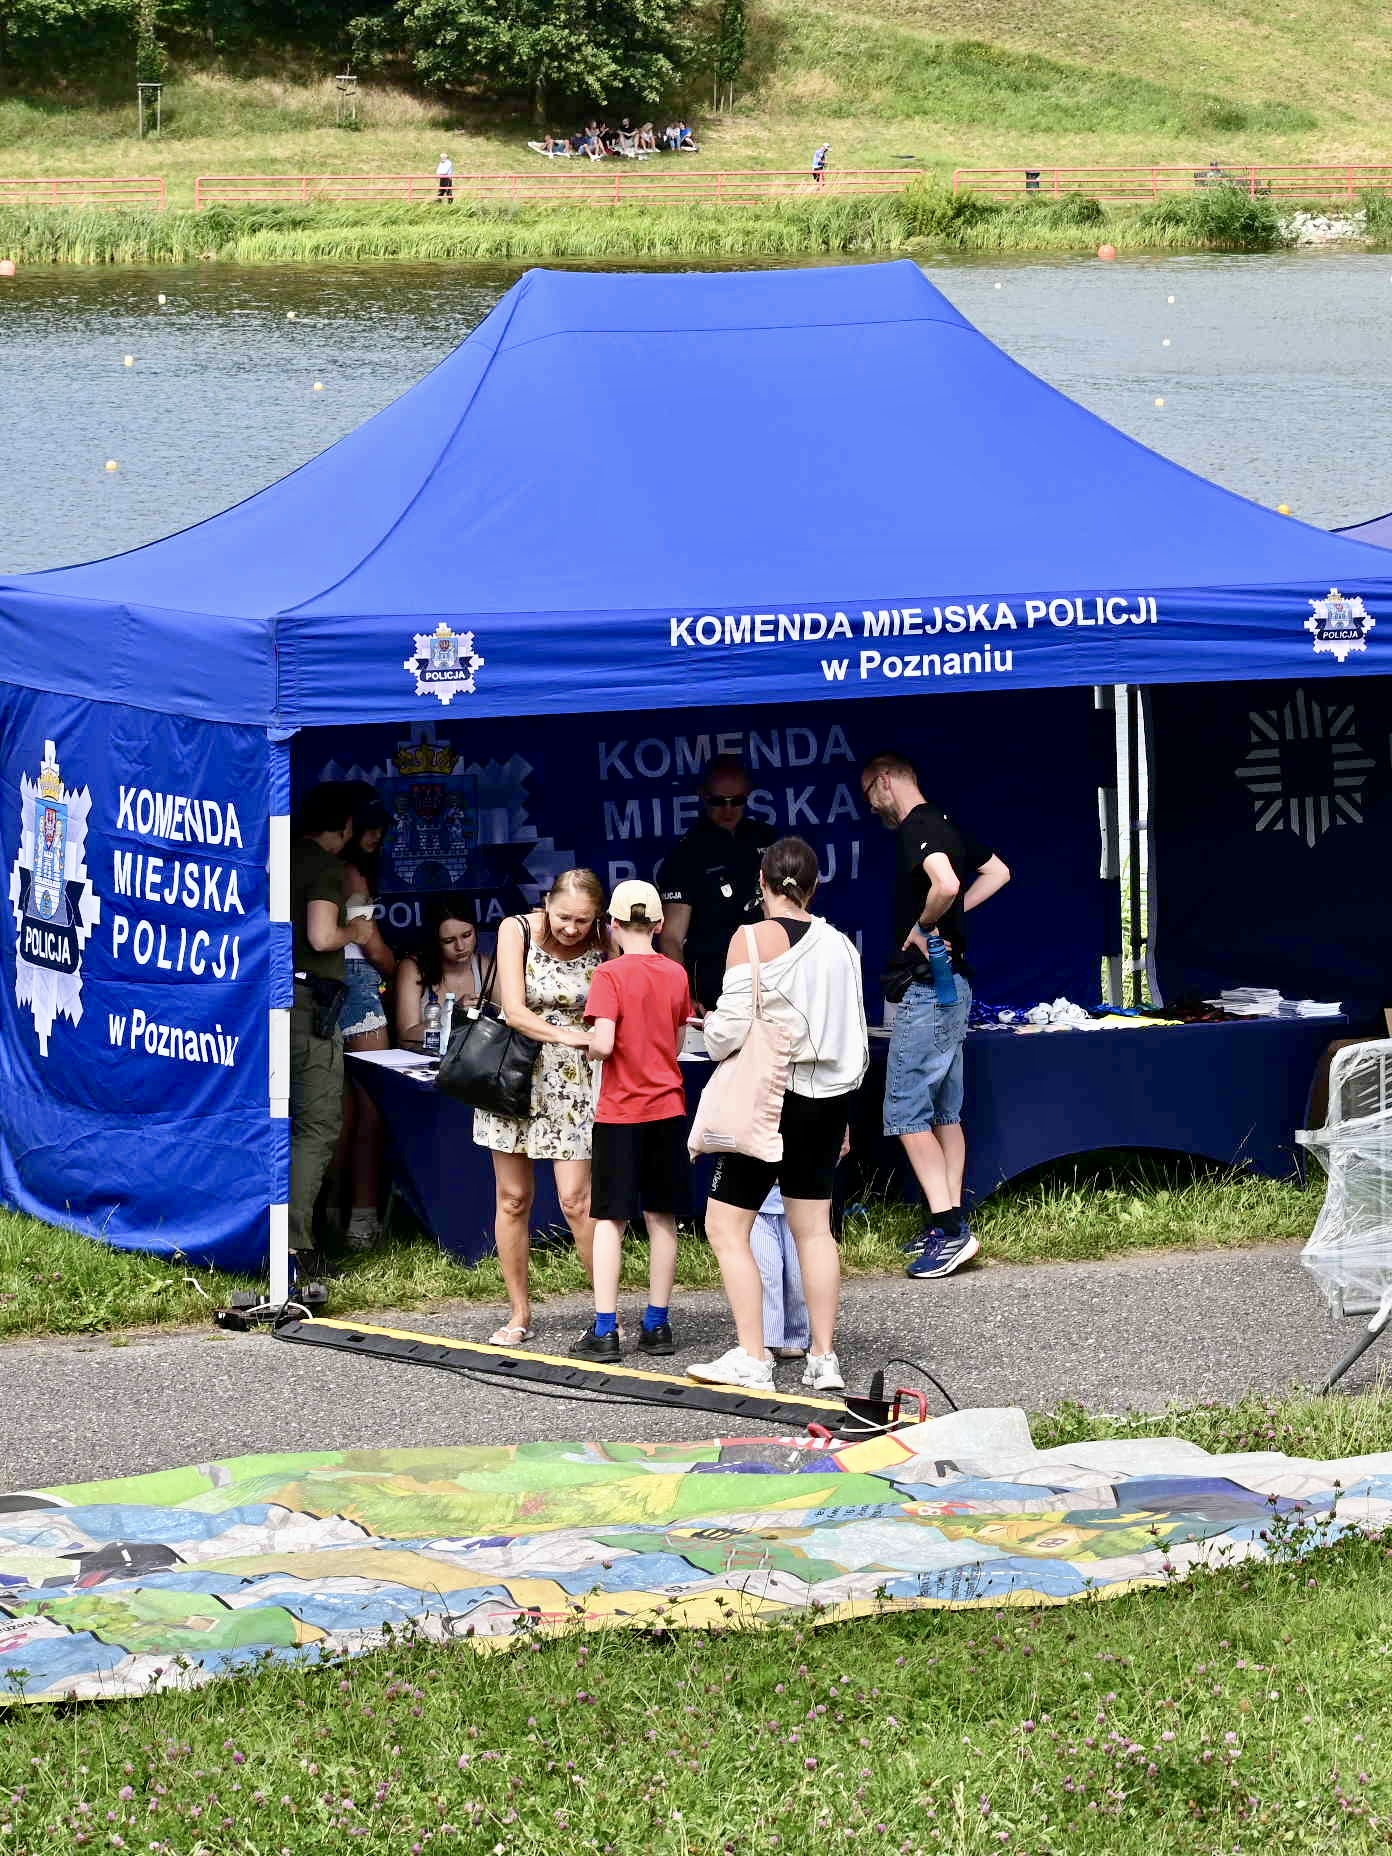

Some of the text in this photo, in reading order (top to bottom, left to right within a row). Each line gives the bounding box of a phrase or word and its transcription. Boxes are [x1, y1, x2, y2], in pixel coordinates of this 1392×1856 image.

[669, 596, 1158, 647] KOMENDA MIEJSKA POLICJI
[1322, 630, 1359, 639] POLICJA
[425, 671, 466, 681] POLICJA
[820, 644, 1014, 681] w Poznaniu
[598, 725, 857, 781] KOMENDA
[116, 785, 244, 849] KOMENDA
[603, 783, 863, 841] MIESKA
[113, 850, 246, 915] MIEJSKA
[25, 925, 72, 966] POLICJA
[112, 914, 241, 980] POLICJI
[109, 1008, 241, 1067] w Poznaniu
